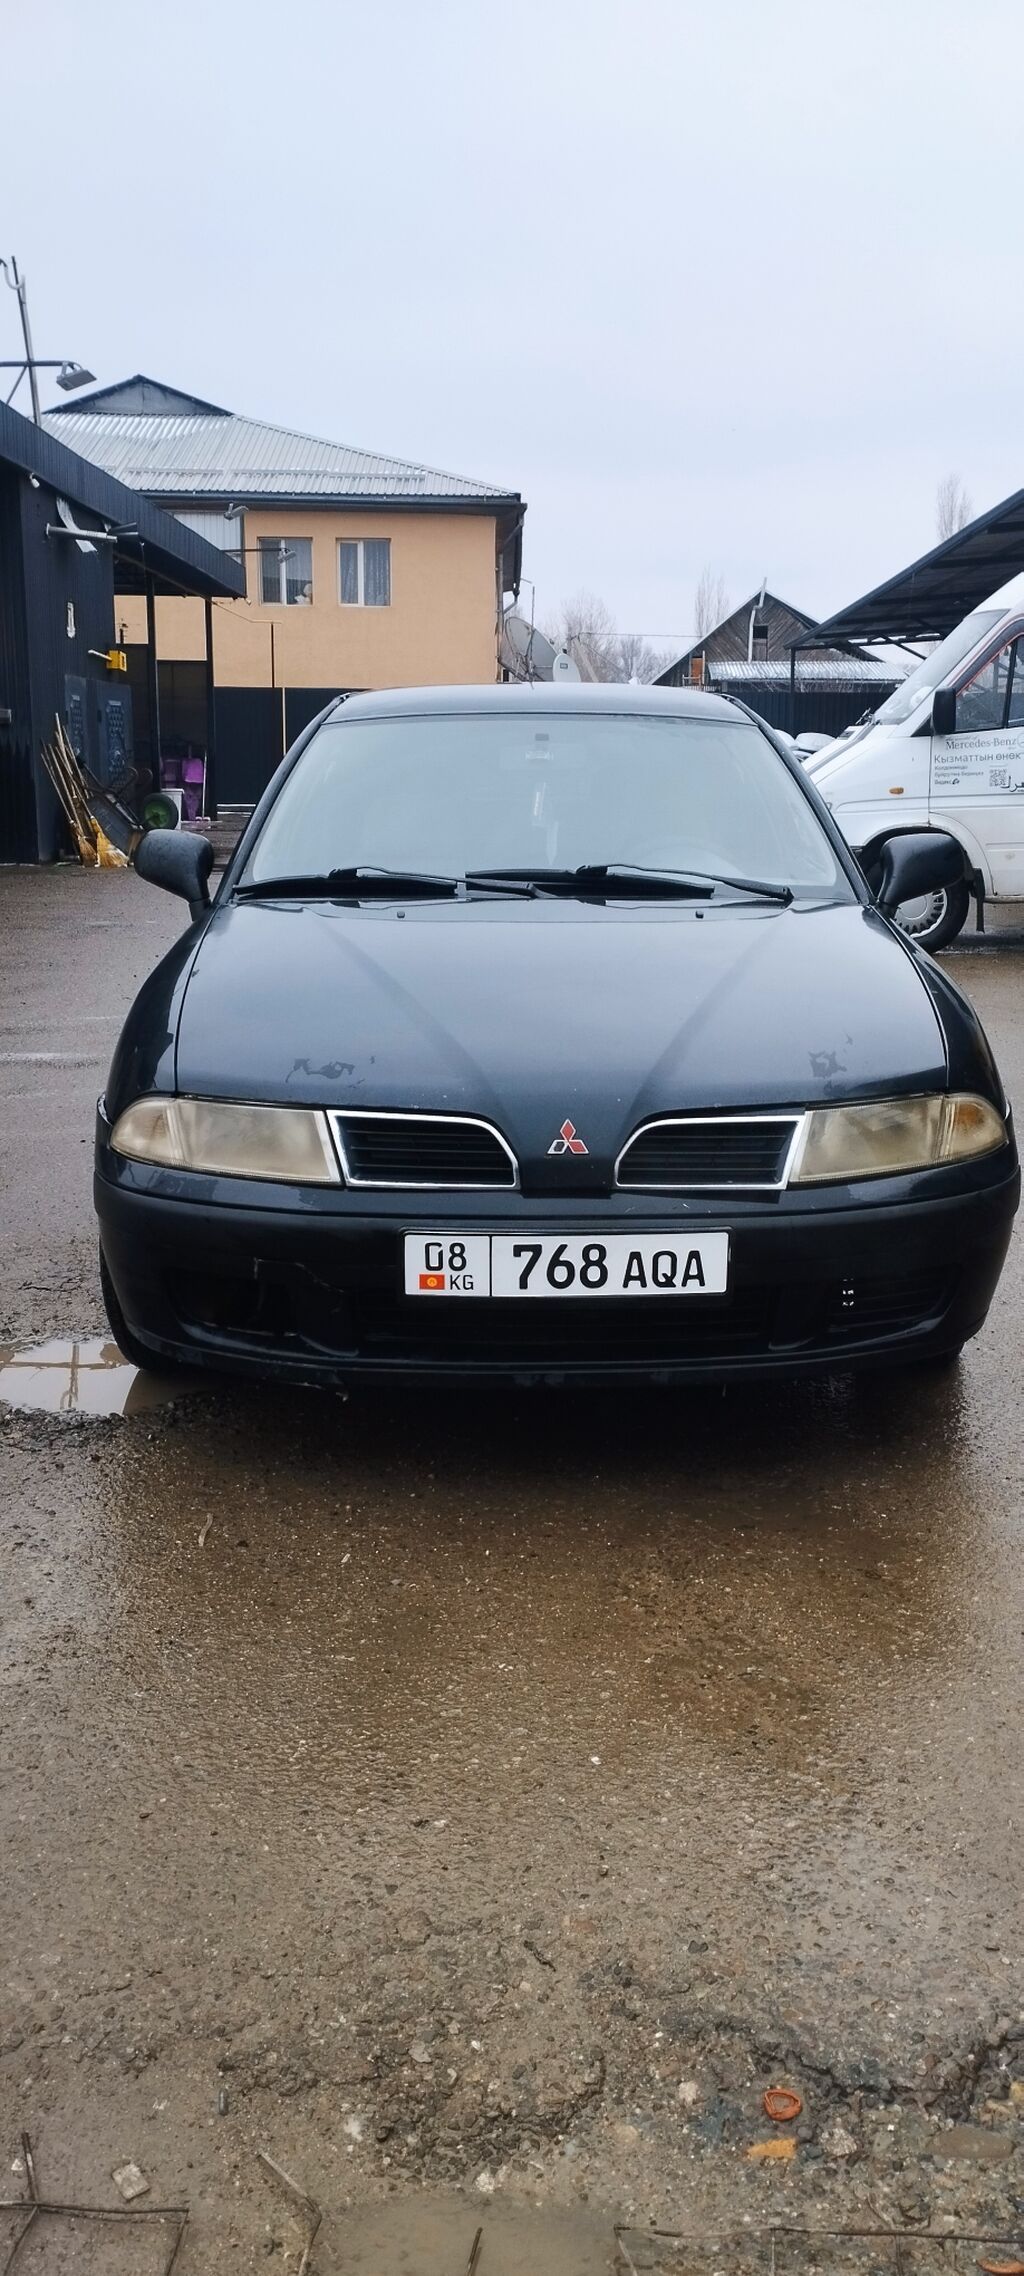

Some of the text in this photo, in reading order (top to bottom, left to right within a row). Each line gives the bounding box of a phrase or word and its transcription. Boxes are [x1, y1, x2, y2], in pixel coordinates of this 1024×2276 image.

[946, 738, 1017, 750] Mercedes-Benz
[934, 754, 994, 764] Кызматтын
[425, 1241, 467, 1272] 08
[513, 1243, 706, 1290] 768 AQA
[449, 1274, 474, 1291] KG
